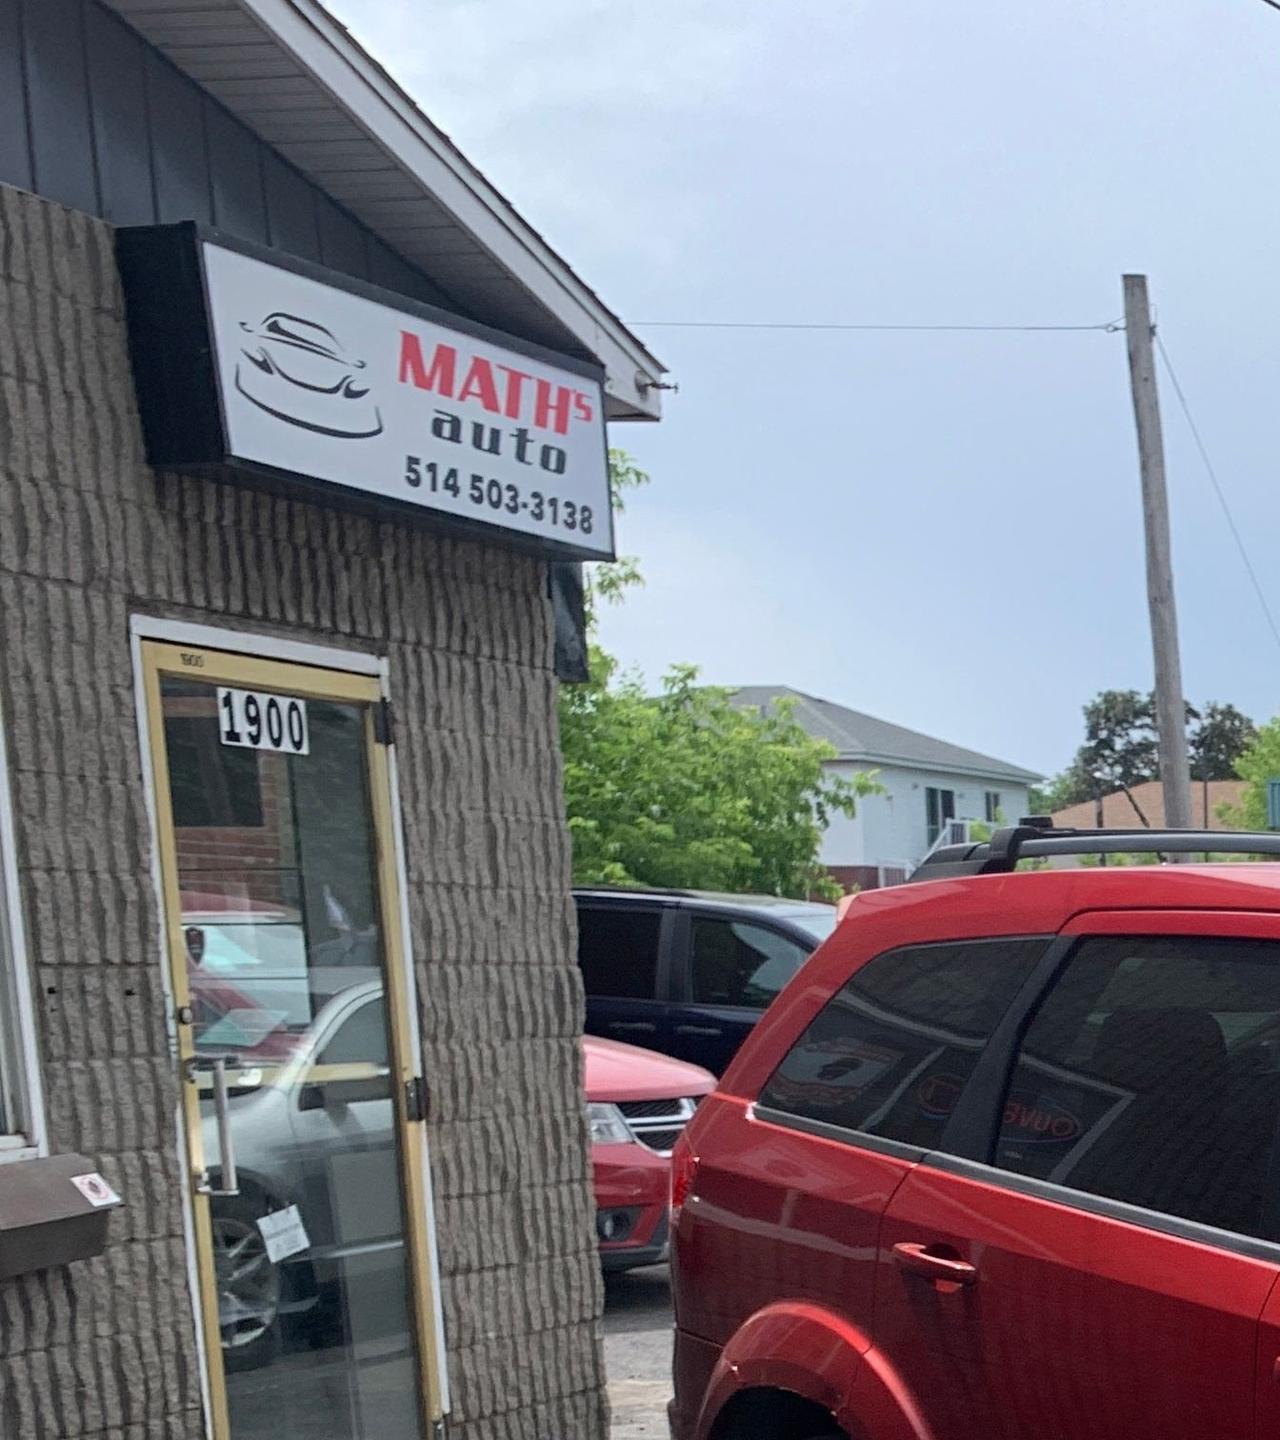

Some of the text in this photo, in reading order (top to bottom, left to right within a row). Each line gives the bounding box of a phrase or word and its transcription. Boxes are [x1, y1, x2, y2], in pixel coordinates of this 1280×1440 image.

[431, 408, 566, 475] auto
[405, 456, 593, 534] 514 503-3138
[222, 691, 303, 751] 1900
